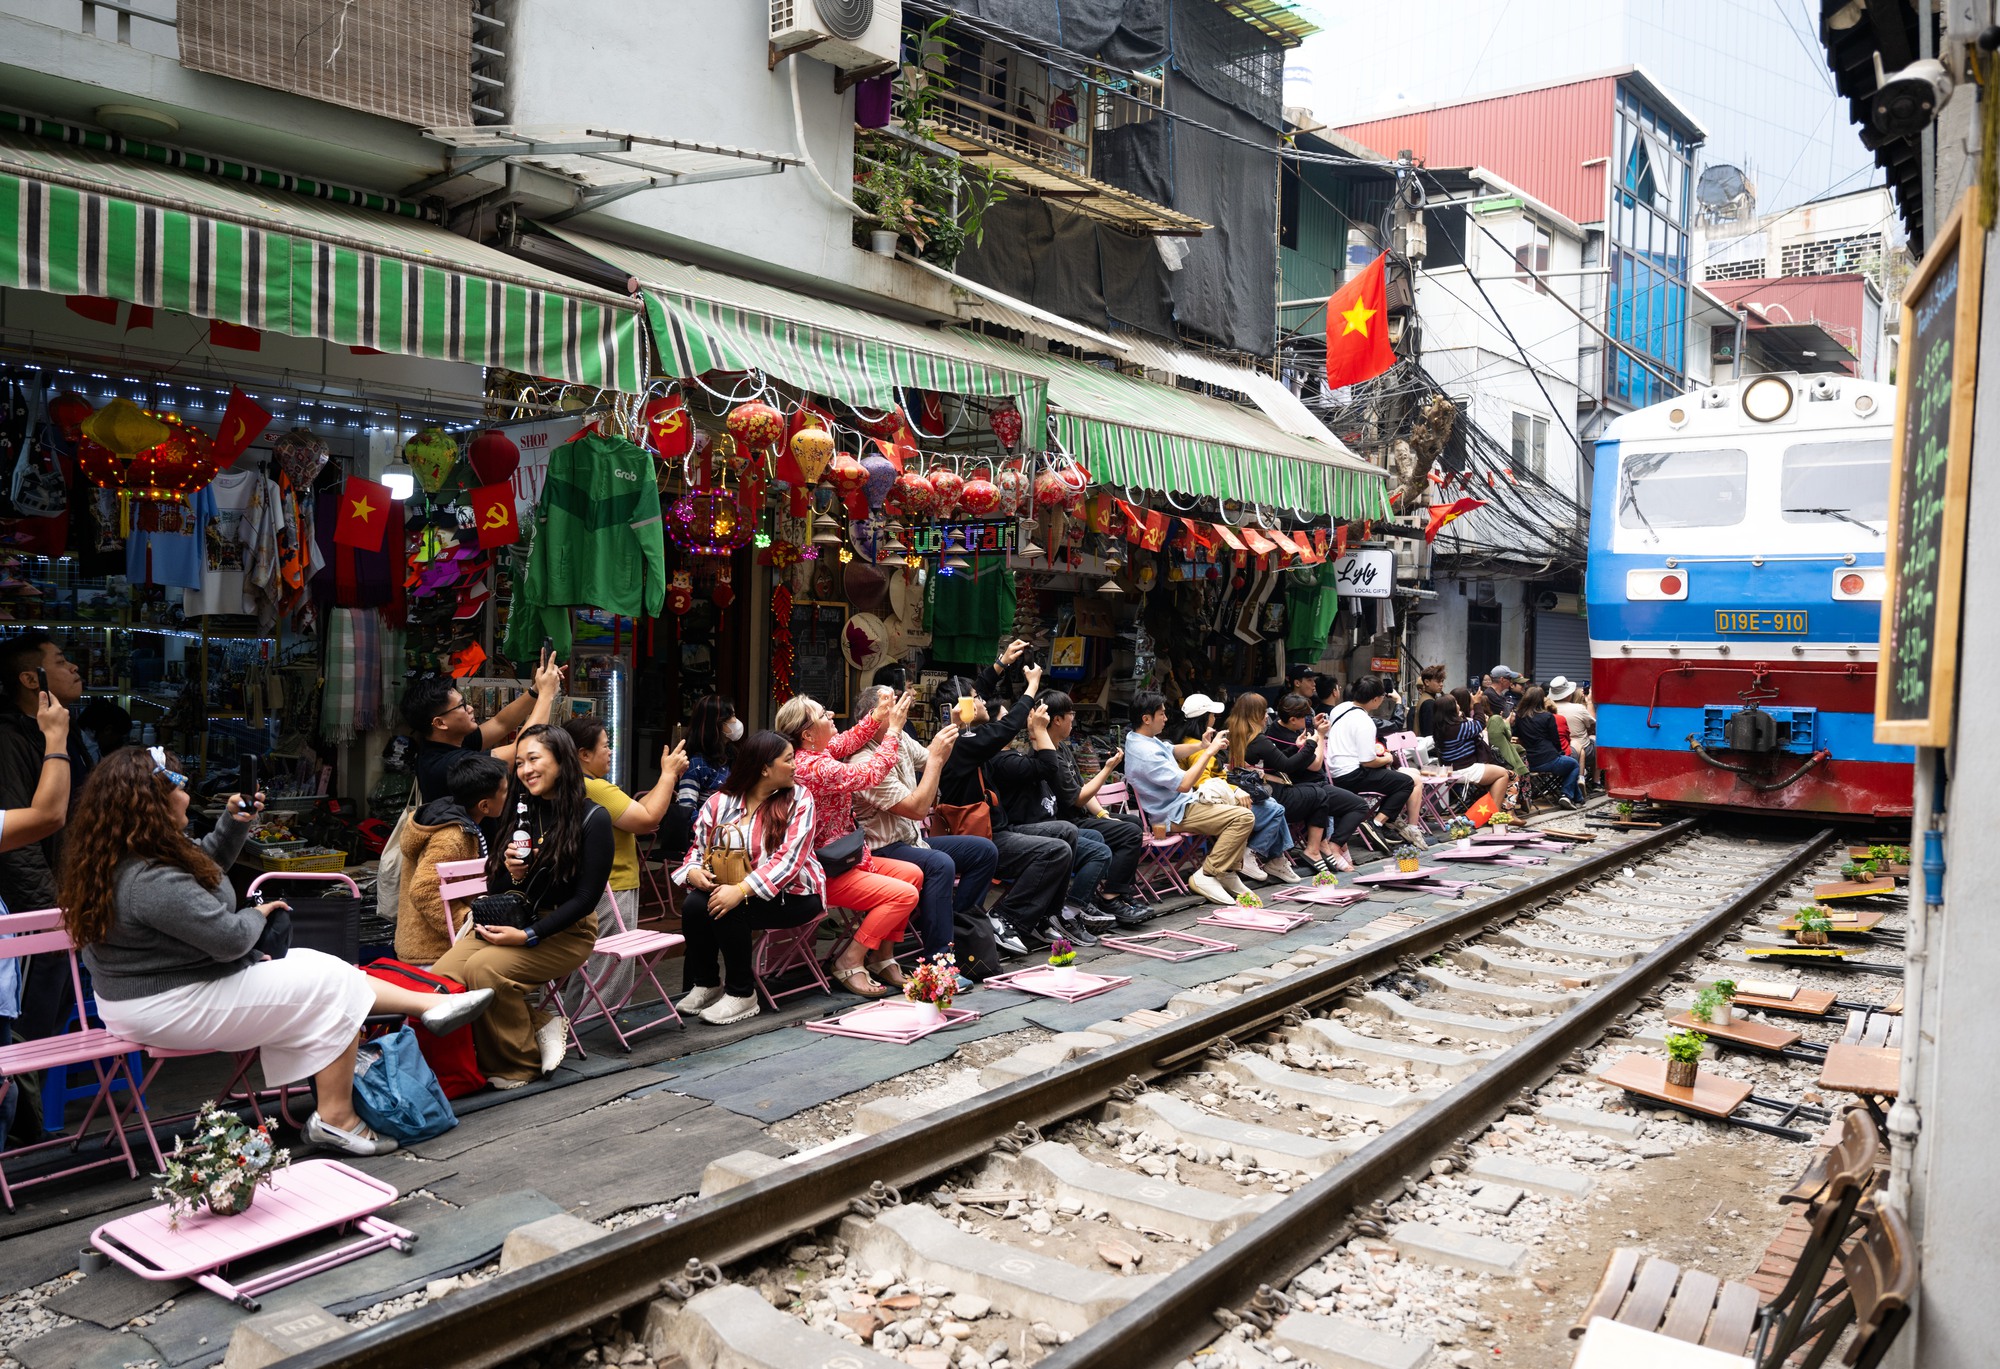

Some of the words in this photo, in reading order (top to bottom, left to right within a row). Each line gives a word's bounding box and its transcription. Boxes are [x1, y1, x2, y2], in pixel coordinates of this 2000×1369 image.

[520, 432, 548, 449] SHOP
[614, 468, 637, 481] Grab
[1337, 558, 1378, 586] Lyly
[674, 595, 685, 609] 2
[1719, 613, 1804, 631] D19E-910
